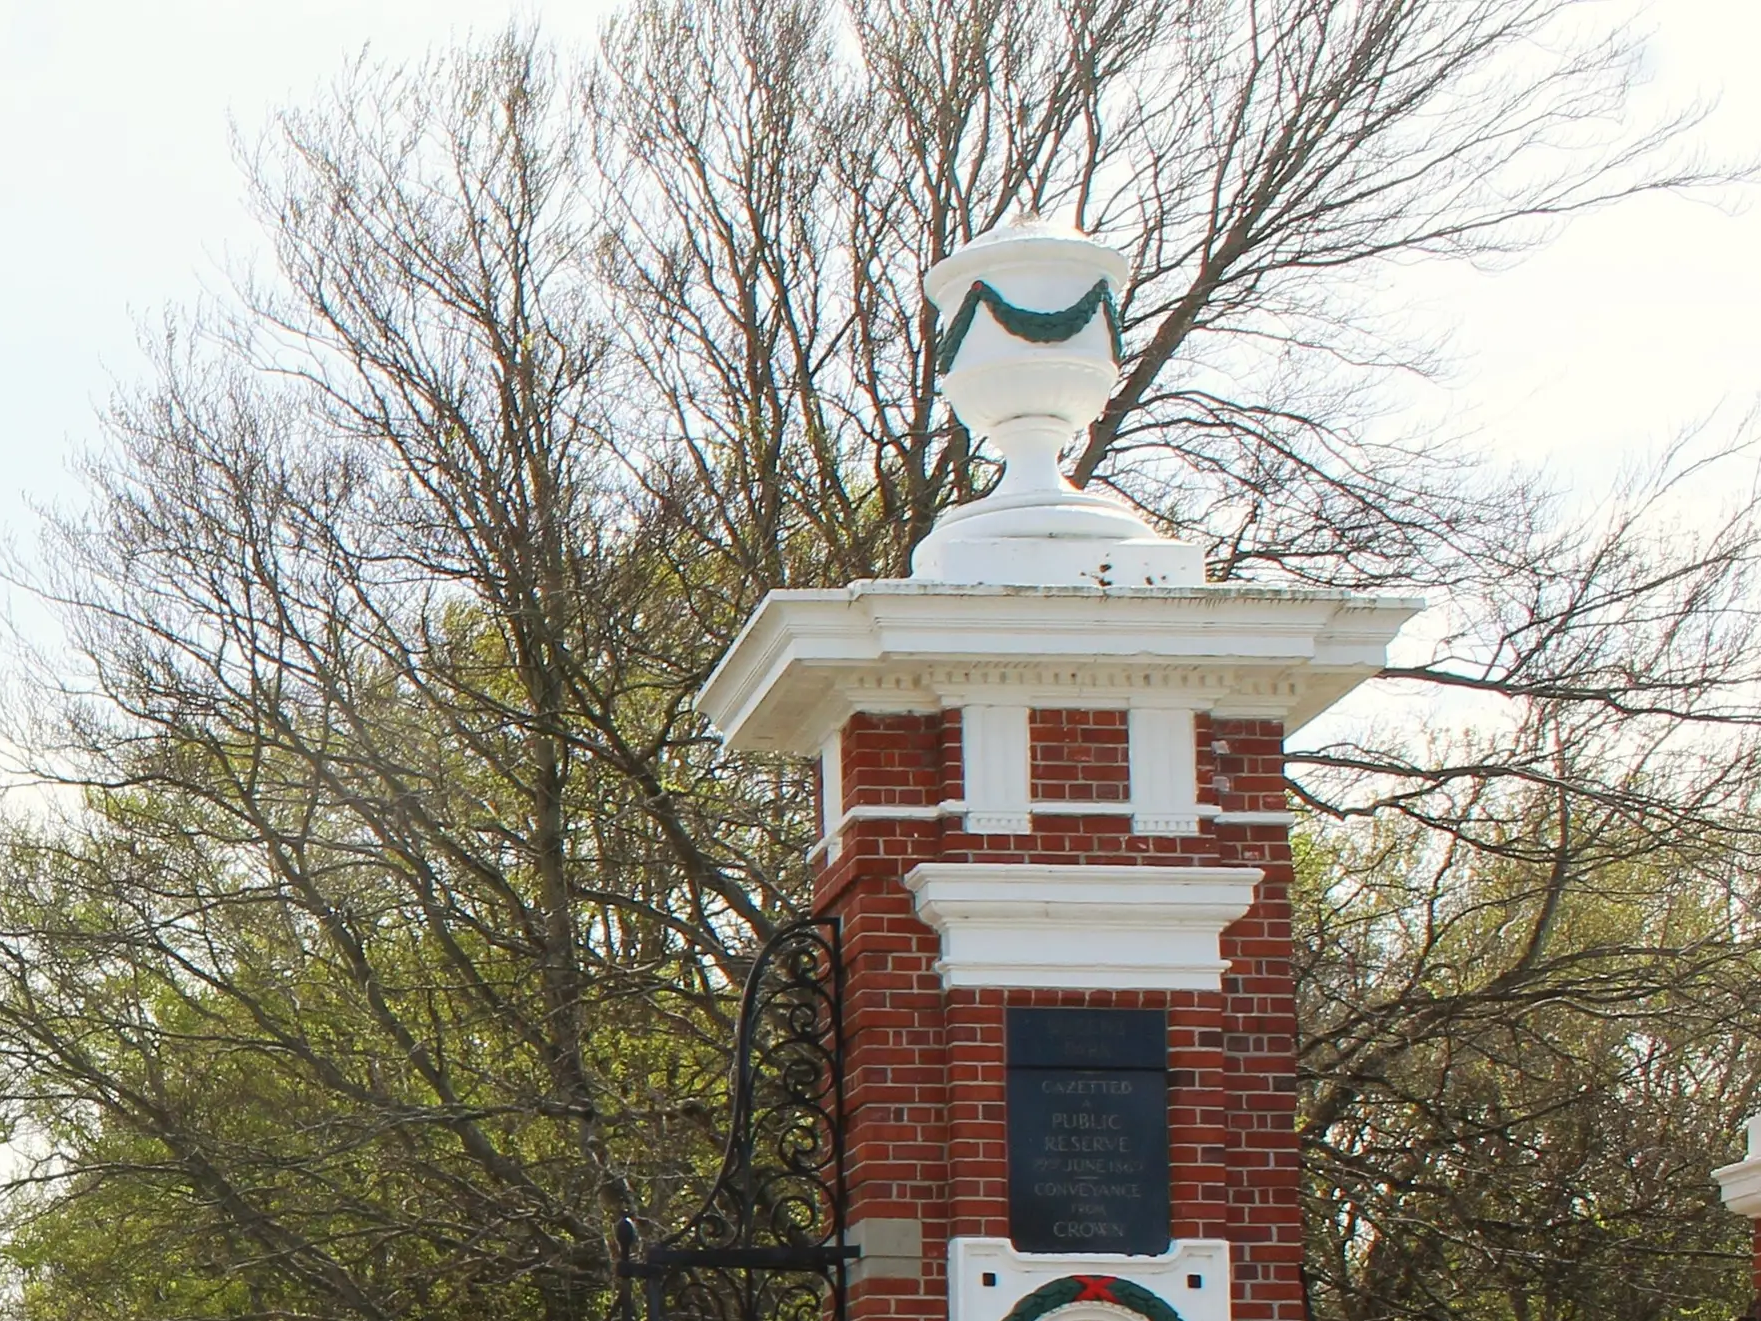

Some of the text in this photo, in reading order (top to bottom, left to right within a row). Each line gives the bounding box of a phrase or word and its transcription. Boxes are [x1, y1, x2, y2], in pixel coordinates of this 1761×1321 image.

[1041, 1080, 1133, 1094] GAZETTED
[1052, 1113, 1122, 1130] PUBLIC
[1044, 1136, 1131, 1152] RESERVE
[1063, 1159, 1106, 1173] JUNE
[1034, 1182, 1141, 1198] CONVEYANCE
[1053, 1221, 1125, 1237] CROWN
